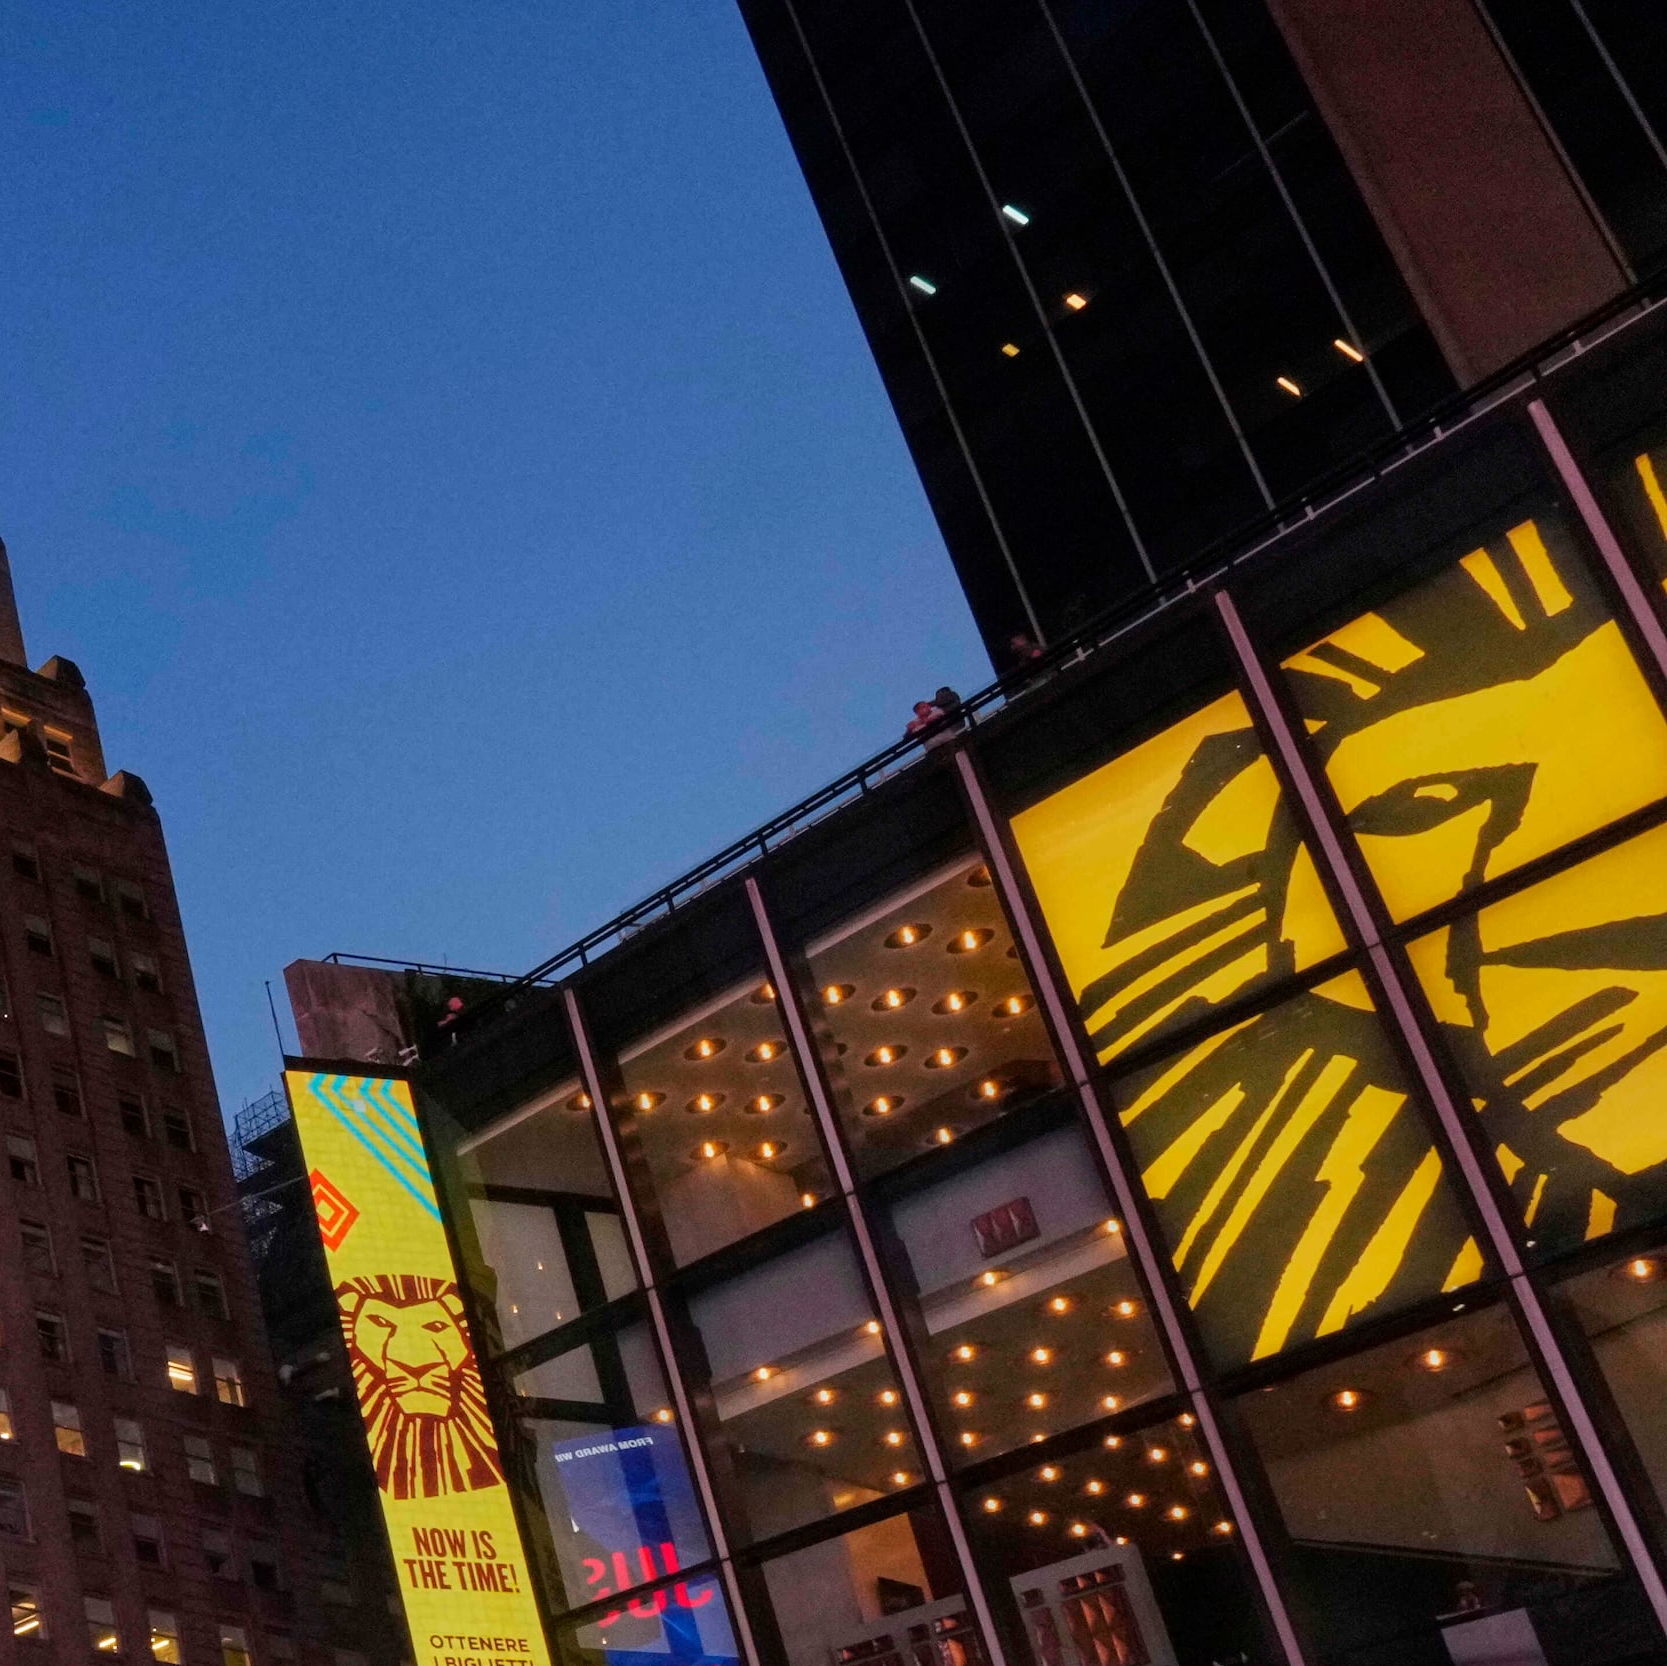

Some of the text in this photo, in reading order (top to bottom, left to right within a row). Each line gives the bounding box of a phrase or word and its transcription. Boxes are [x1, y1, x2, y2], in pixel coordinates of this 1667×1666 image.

[412, 1528, 497, 1560] NOW IS
[403, 1559, 521, 1593] THE TIME!
[430, 1635, 530, 1652] OTTENERE
